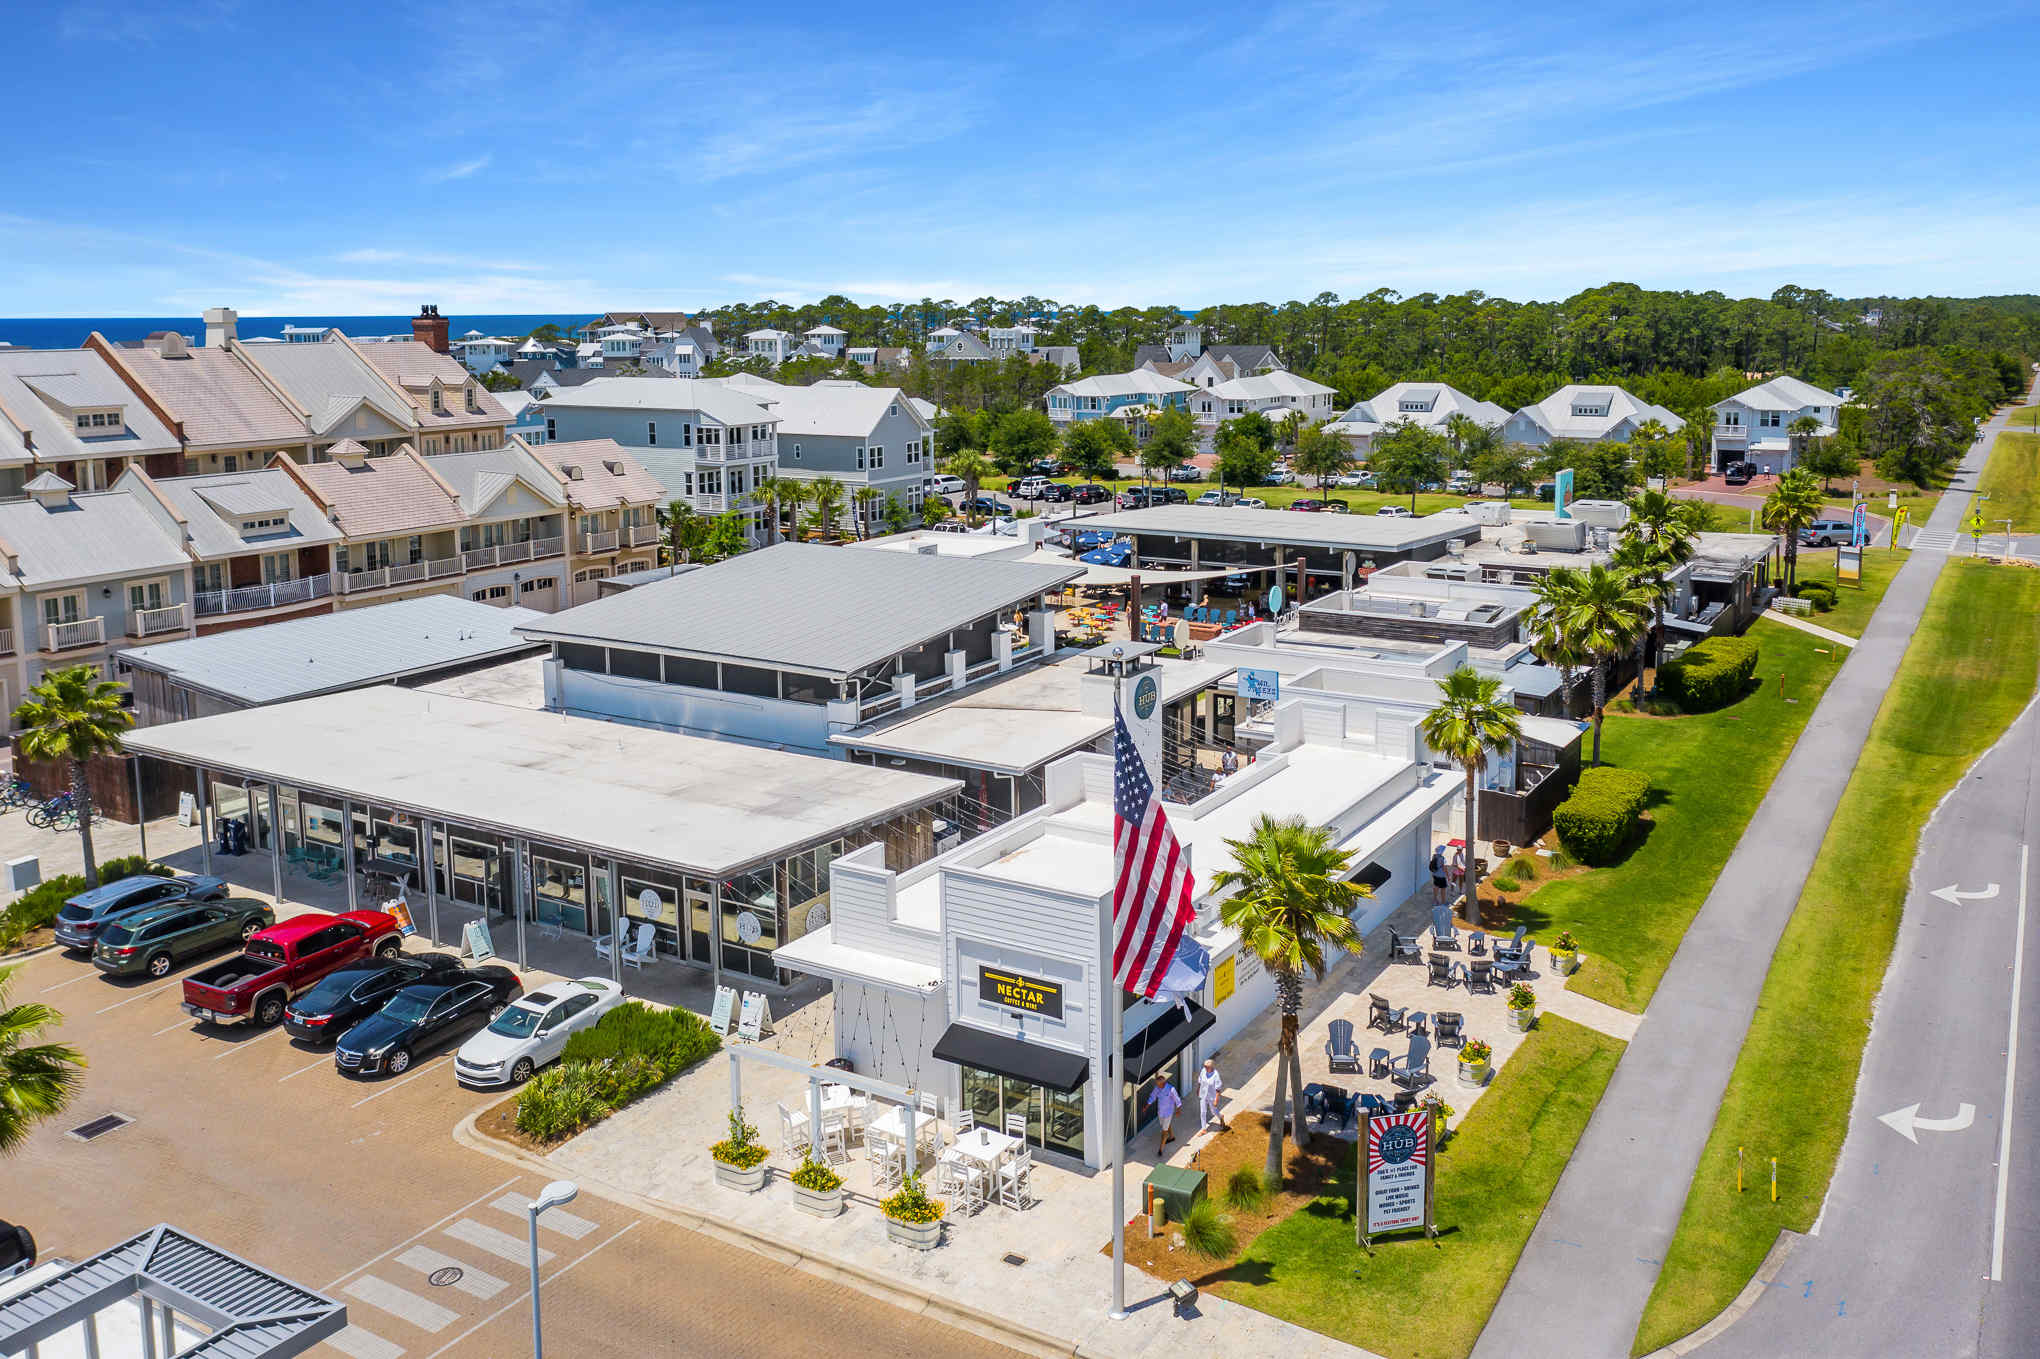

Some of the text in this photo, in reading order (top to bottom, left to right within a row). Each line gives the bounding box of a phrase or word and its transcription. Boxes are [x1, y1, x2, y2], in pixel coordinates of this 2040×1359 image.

[1138, 690, 1156, 706] HUB
[997, 983, 1045, 1005] NECTAR
[1383, 1138, 1415, 1151] HUB
